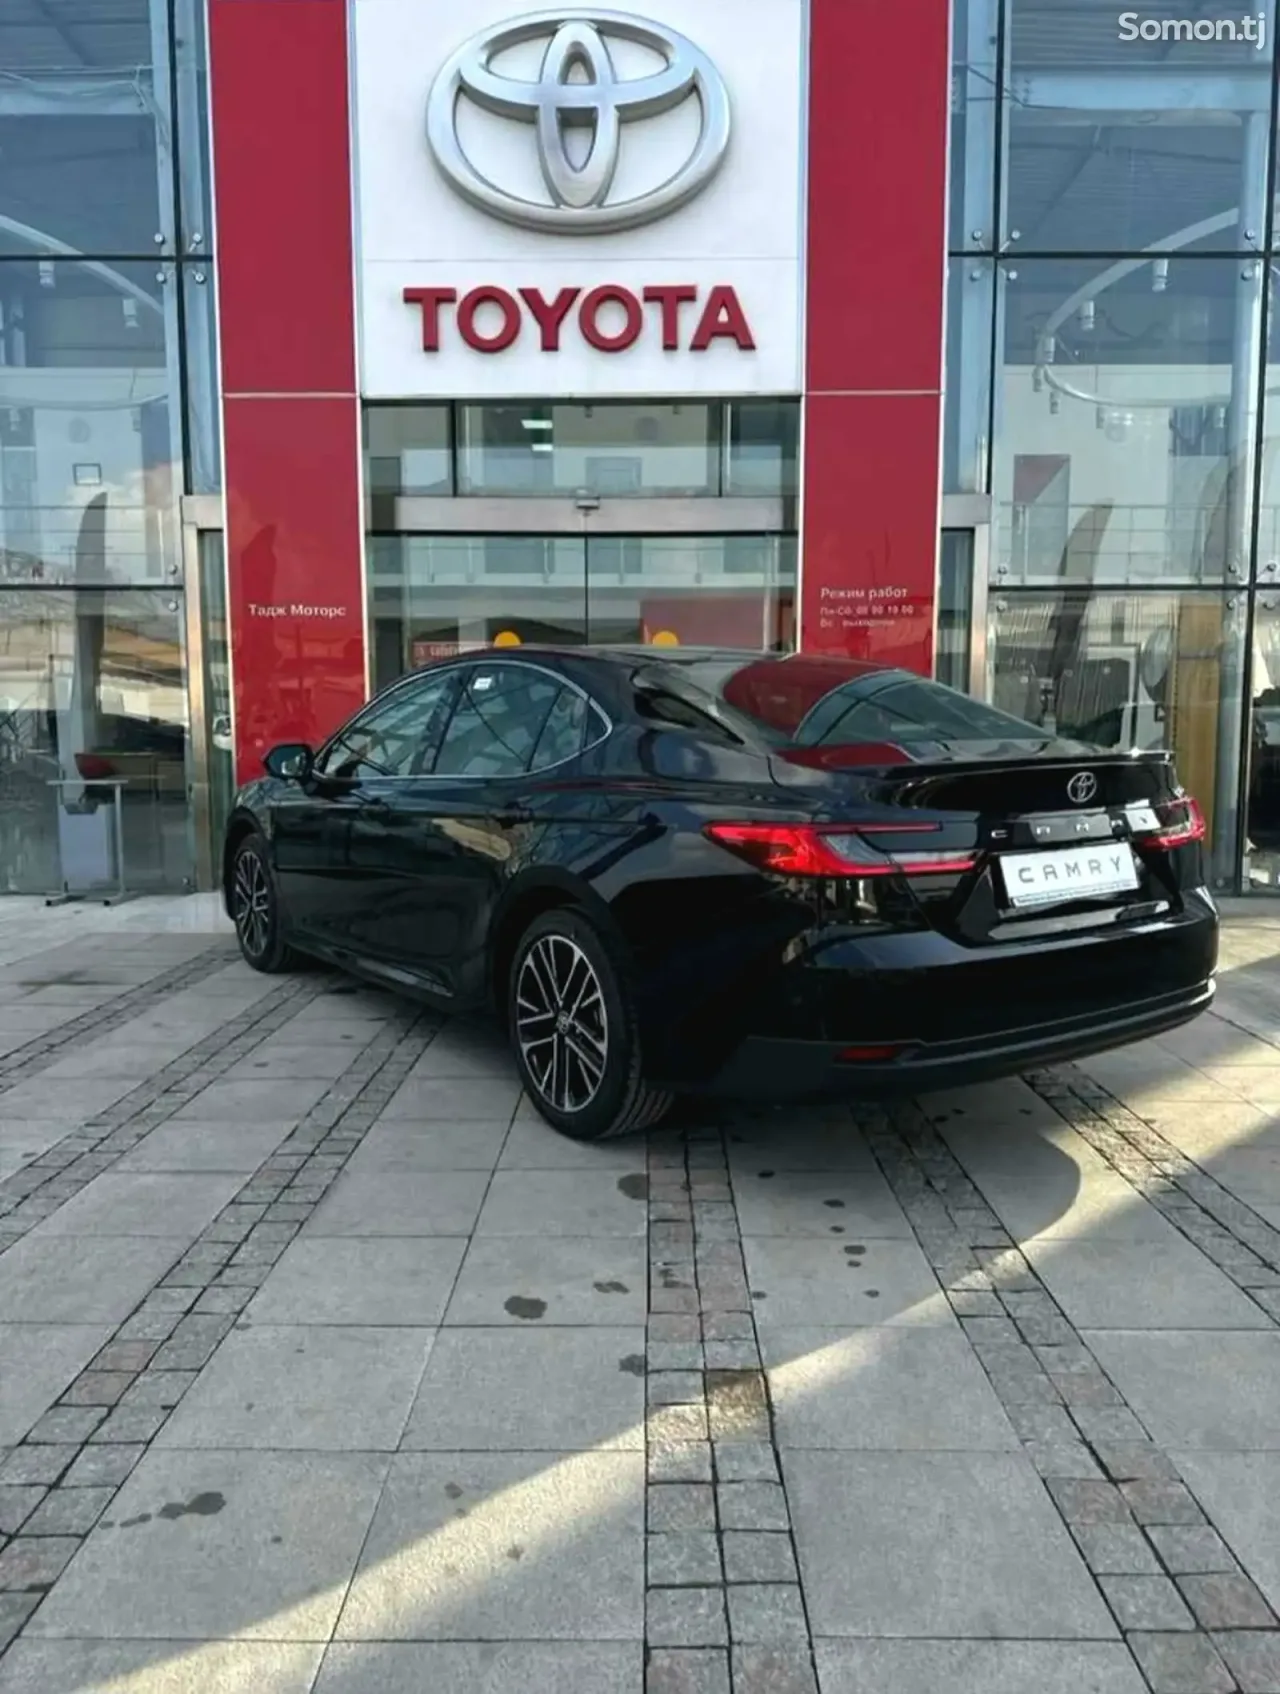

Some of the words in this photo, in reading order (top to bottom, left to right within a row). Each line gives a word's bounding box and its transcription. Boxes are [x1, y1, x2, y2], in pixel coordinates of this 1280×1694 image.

[403, 285, 756, 353] TOYOTA
[820, 587, 865, 600] Режим
[248, 603, 287, 619] Тадж
[290, 604, 346, 619] Моторс
[1017, 855, 1121, 884] CAMRY
